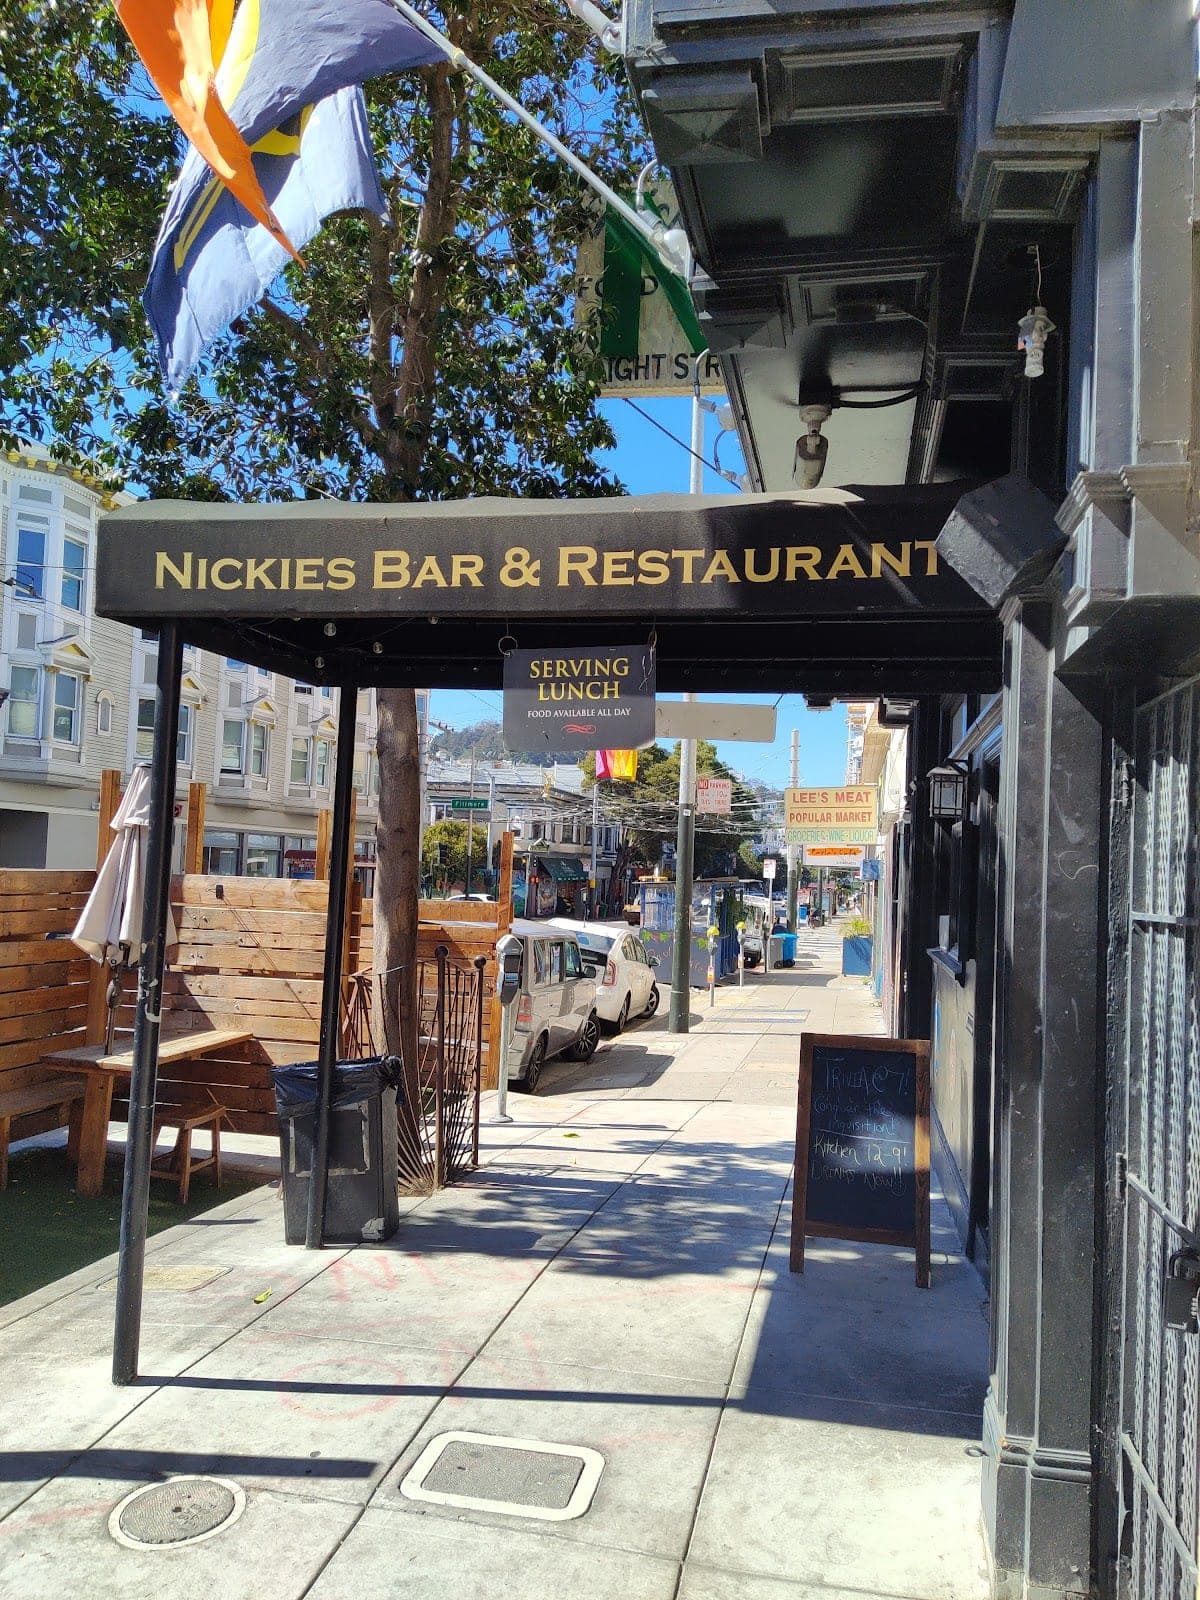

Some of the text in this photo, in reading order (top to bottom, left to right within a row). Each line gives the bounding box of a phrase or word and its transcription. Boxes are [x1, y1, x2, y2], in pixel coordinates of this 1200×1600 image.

[155, 540, 939, 591] NICKIES BAR & RESTAURANT
[529, 657, 630, 679] SERVING
[538, 680, 621, 701] LUNCH
[527, 707, 632, 718] FOOD AVAILABLE ALL DAY
[792, 791, 871, 804] LEE'S MEAT
[789, 811, 873, 823] POPULAR MARKET
[813, 1132, 861, 1166] Kitchen
